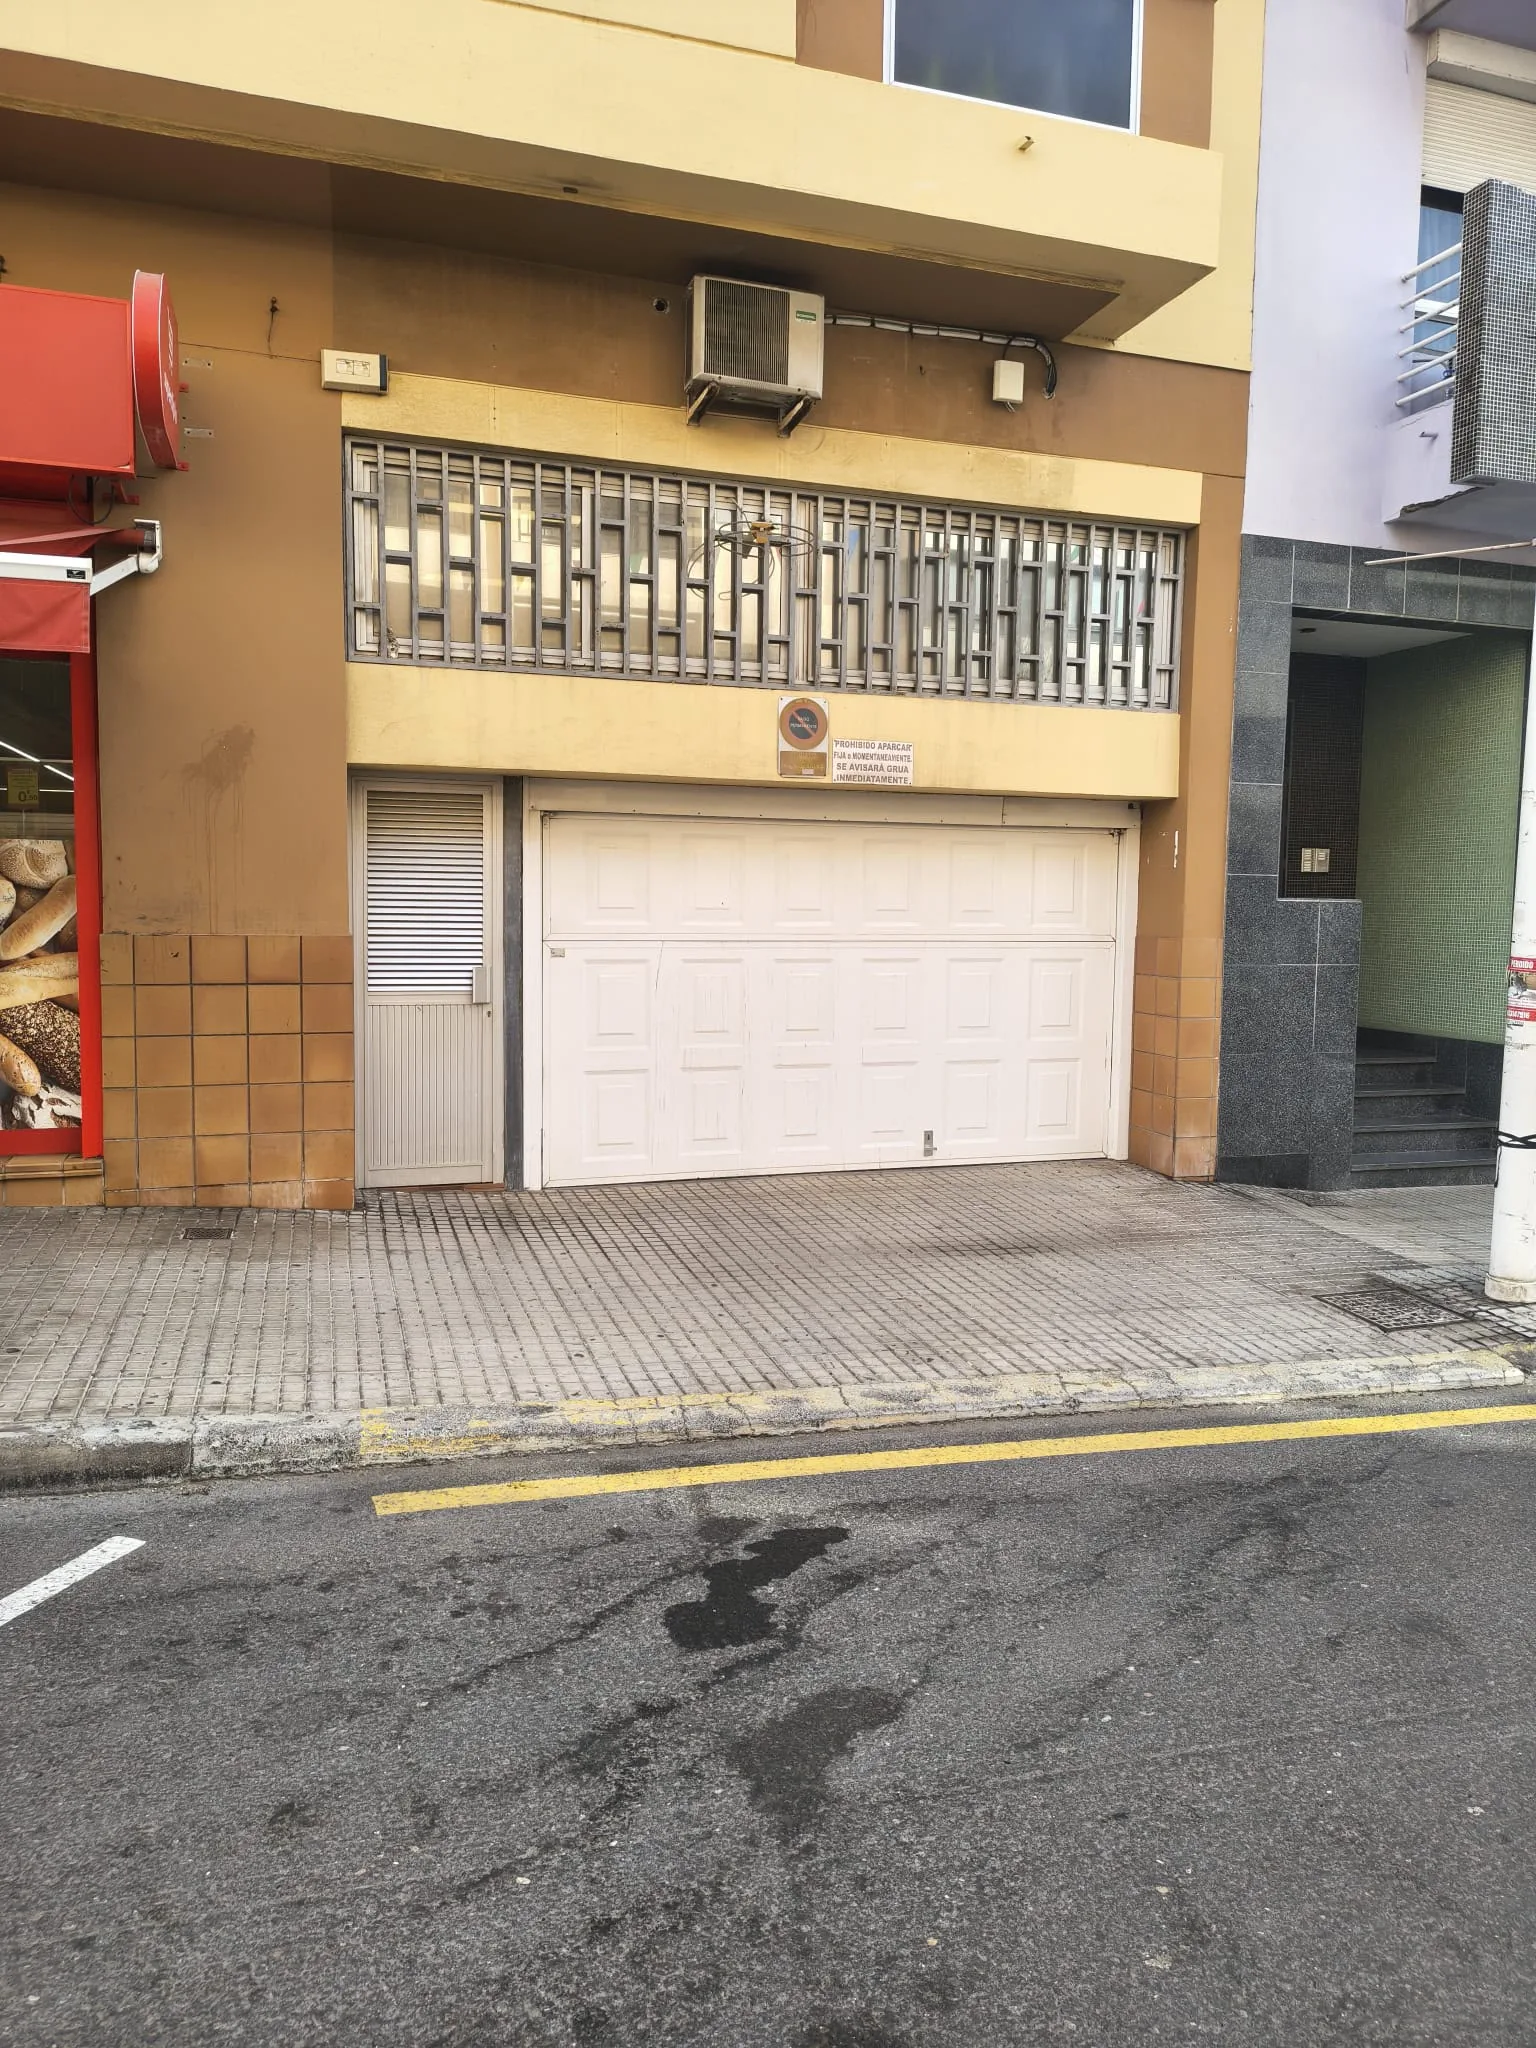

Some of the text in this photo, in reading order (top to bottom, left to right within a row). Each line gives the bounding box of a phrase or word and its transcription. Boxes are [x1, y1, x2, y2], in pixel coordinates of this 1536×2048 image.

[835, 740, 911, 751] PROHIBIDO APARCAR
[887, 765, 909, 773] GRUA
